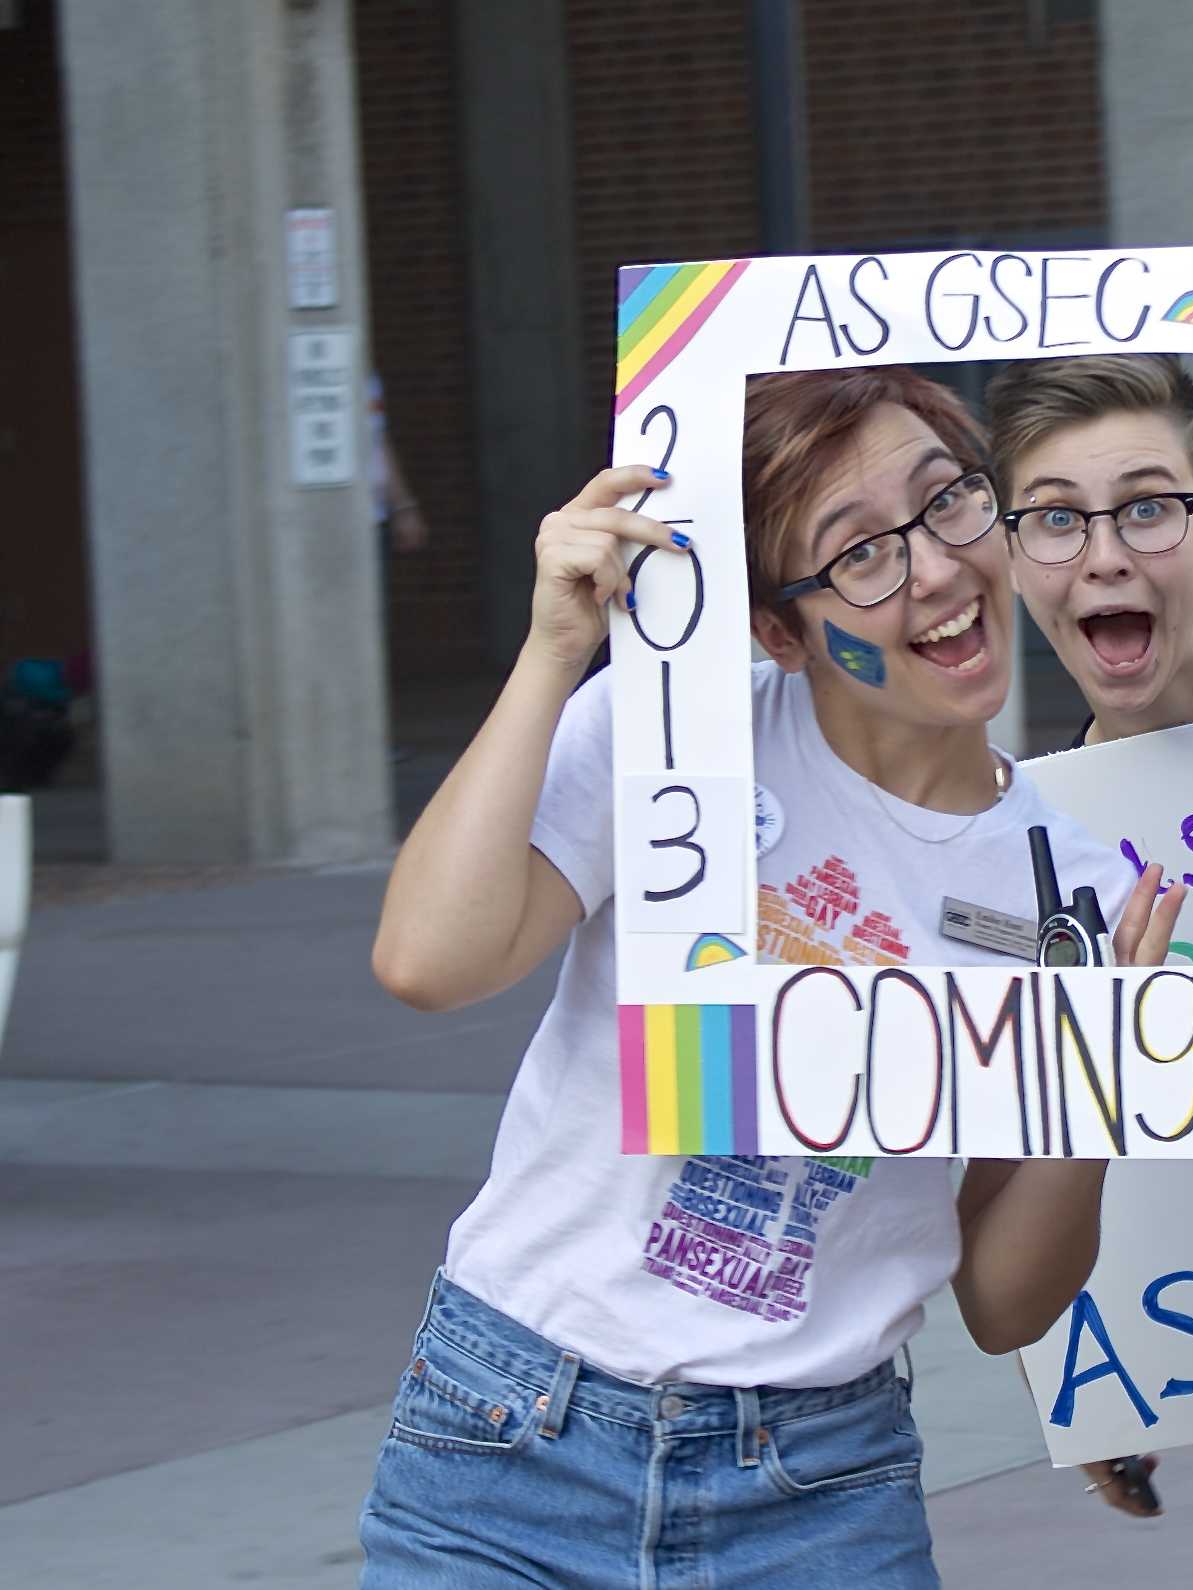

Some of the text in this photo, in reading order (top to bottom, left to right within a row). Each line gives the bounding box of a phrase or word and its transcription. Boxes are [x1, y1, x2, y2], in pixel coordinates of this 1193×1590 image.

[779, 255, 890, 366] AS
[924, 252, 1152, 351] GSEC
[645, 1221, 774, 1299] PANSEXUAL
